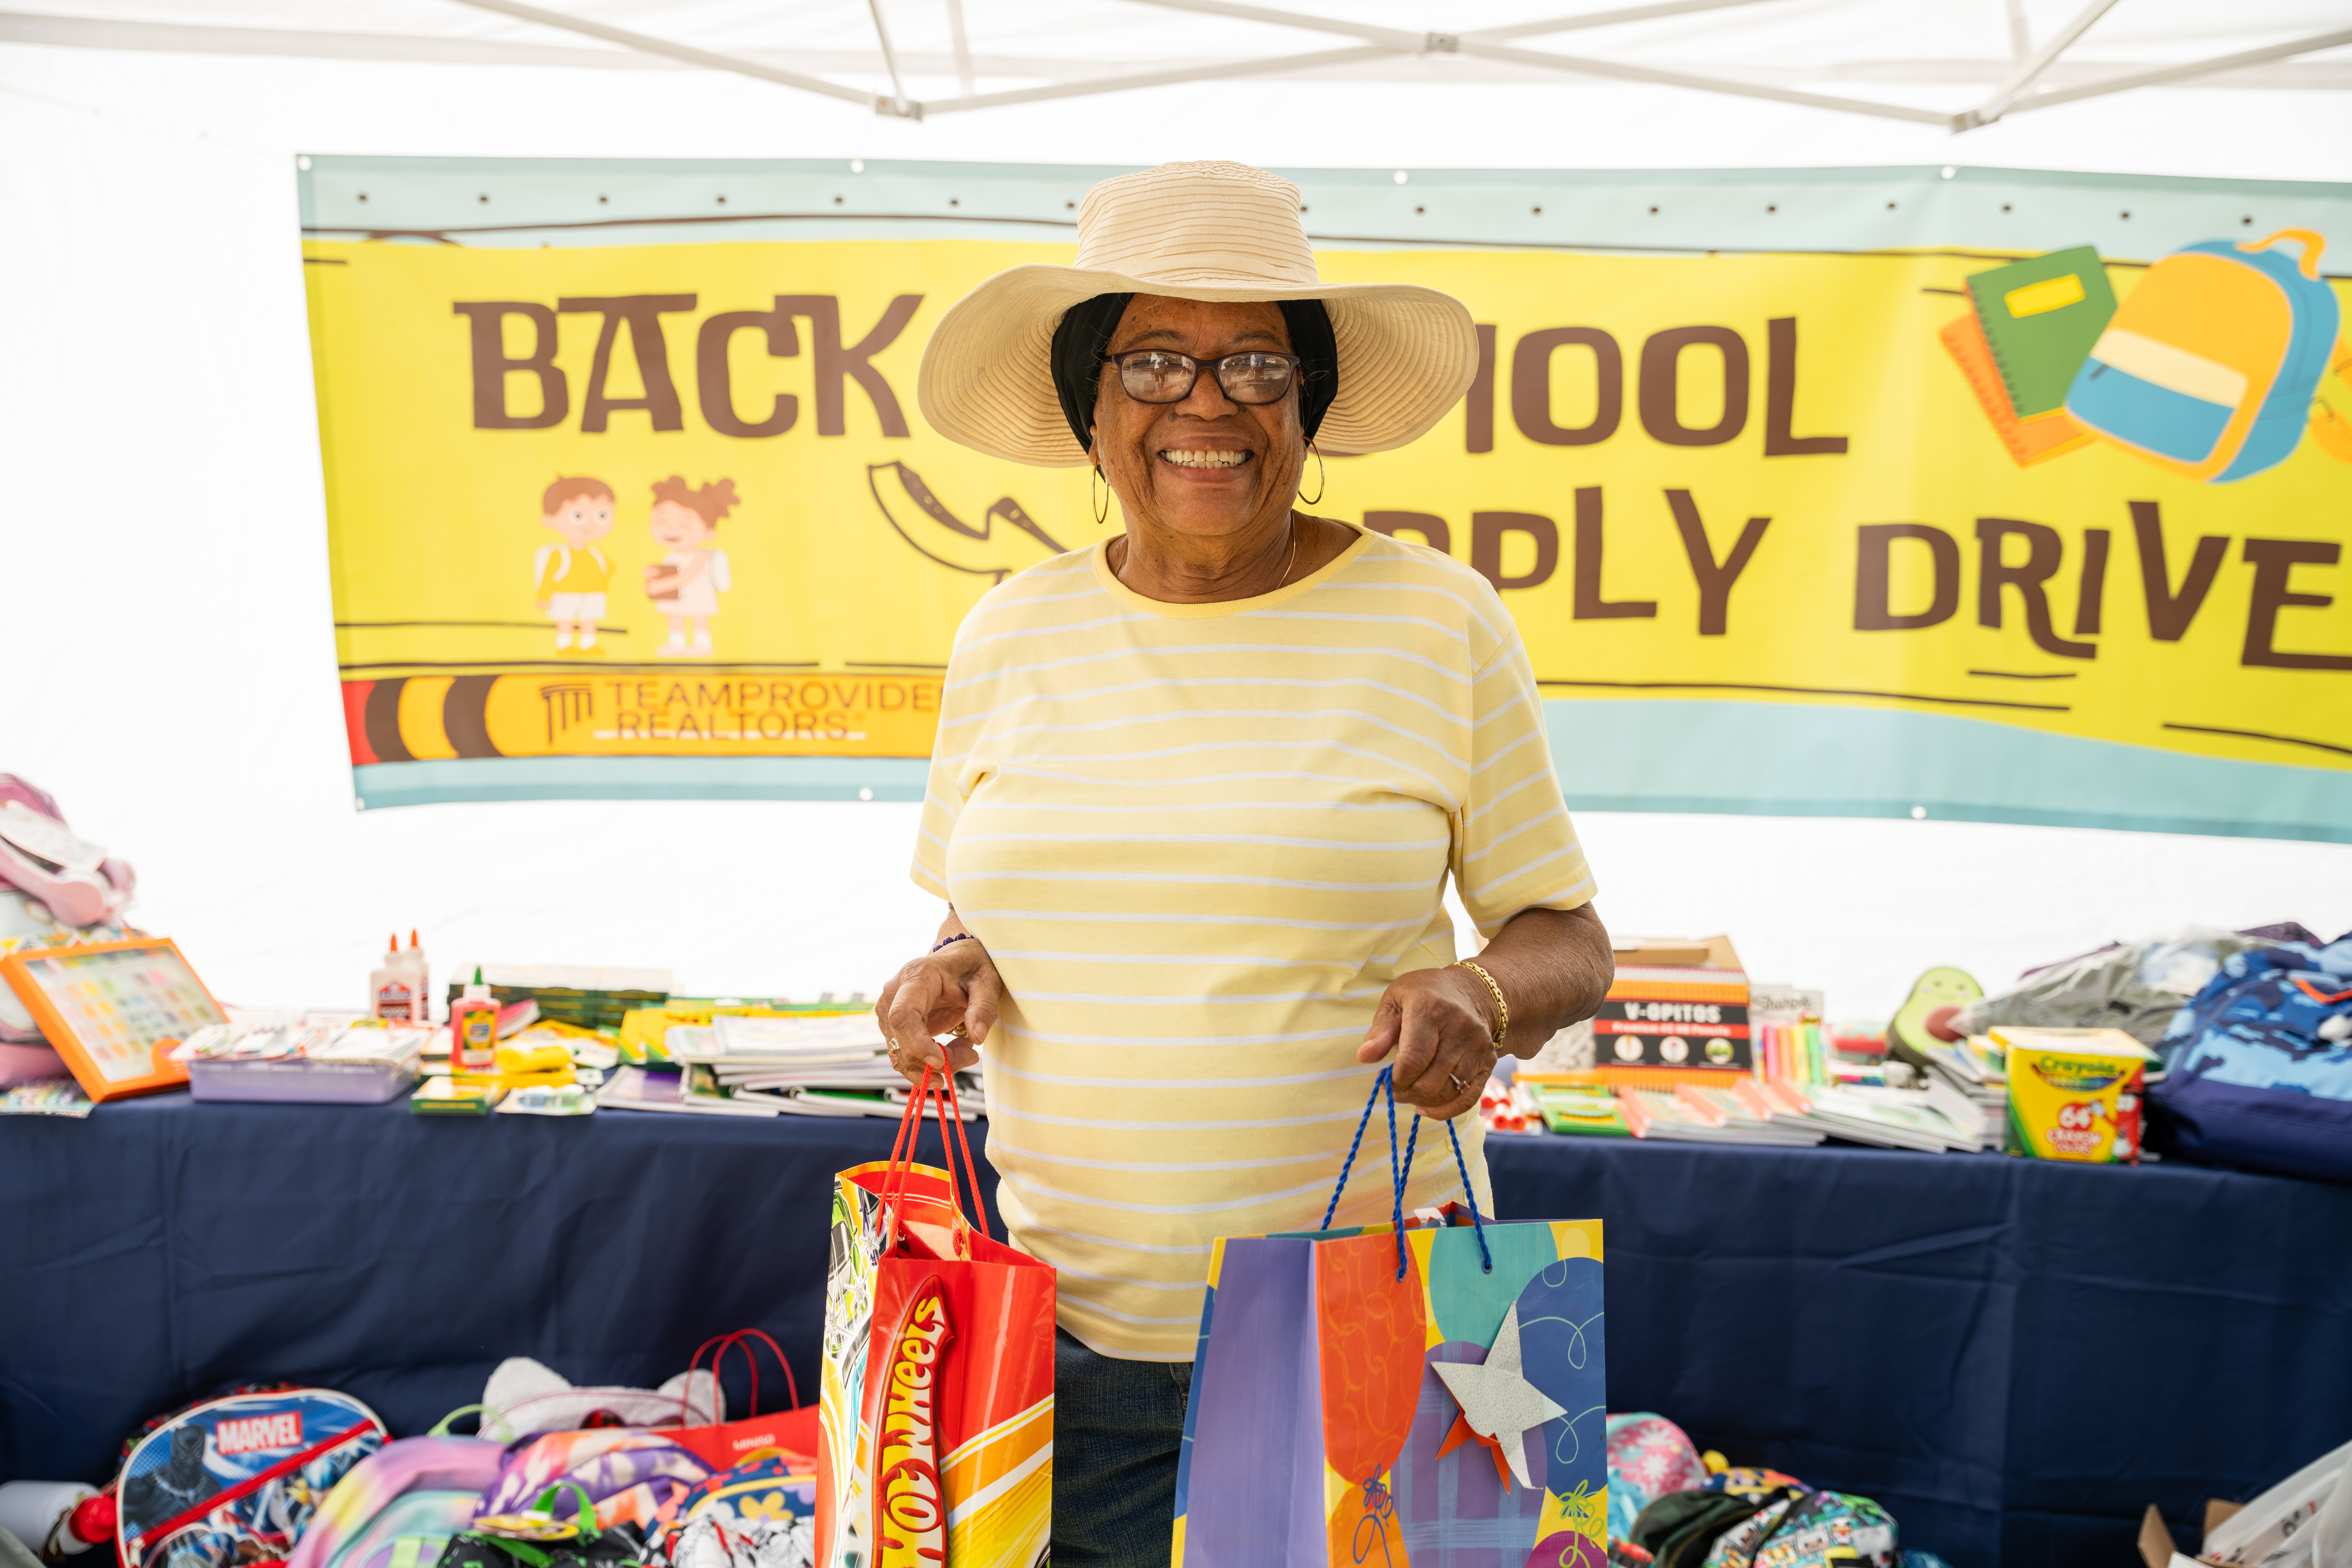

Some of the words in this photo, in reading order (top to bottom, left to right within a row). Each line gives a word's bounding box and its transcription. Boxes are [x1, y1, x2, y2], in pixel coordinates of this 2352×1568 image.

[453, 293, 925, 438] BACK
[1362, 485, 1772, 636] PLY
[1854, 501, 2352, 670] DRIVE
[605, 682, 943, 710] TEAMPROVIDE
[2040, 1055, 2116, 1074] Crayola
[2059, 1106, 2093, 1129] 64
[218, 1413, 302, 1453] MARVEL
[732, 1433, 776, 1451] MINISO
